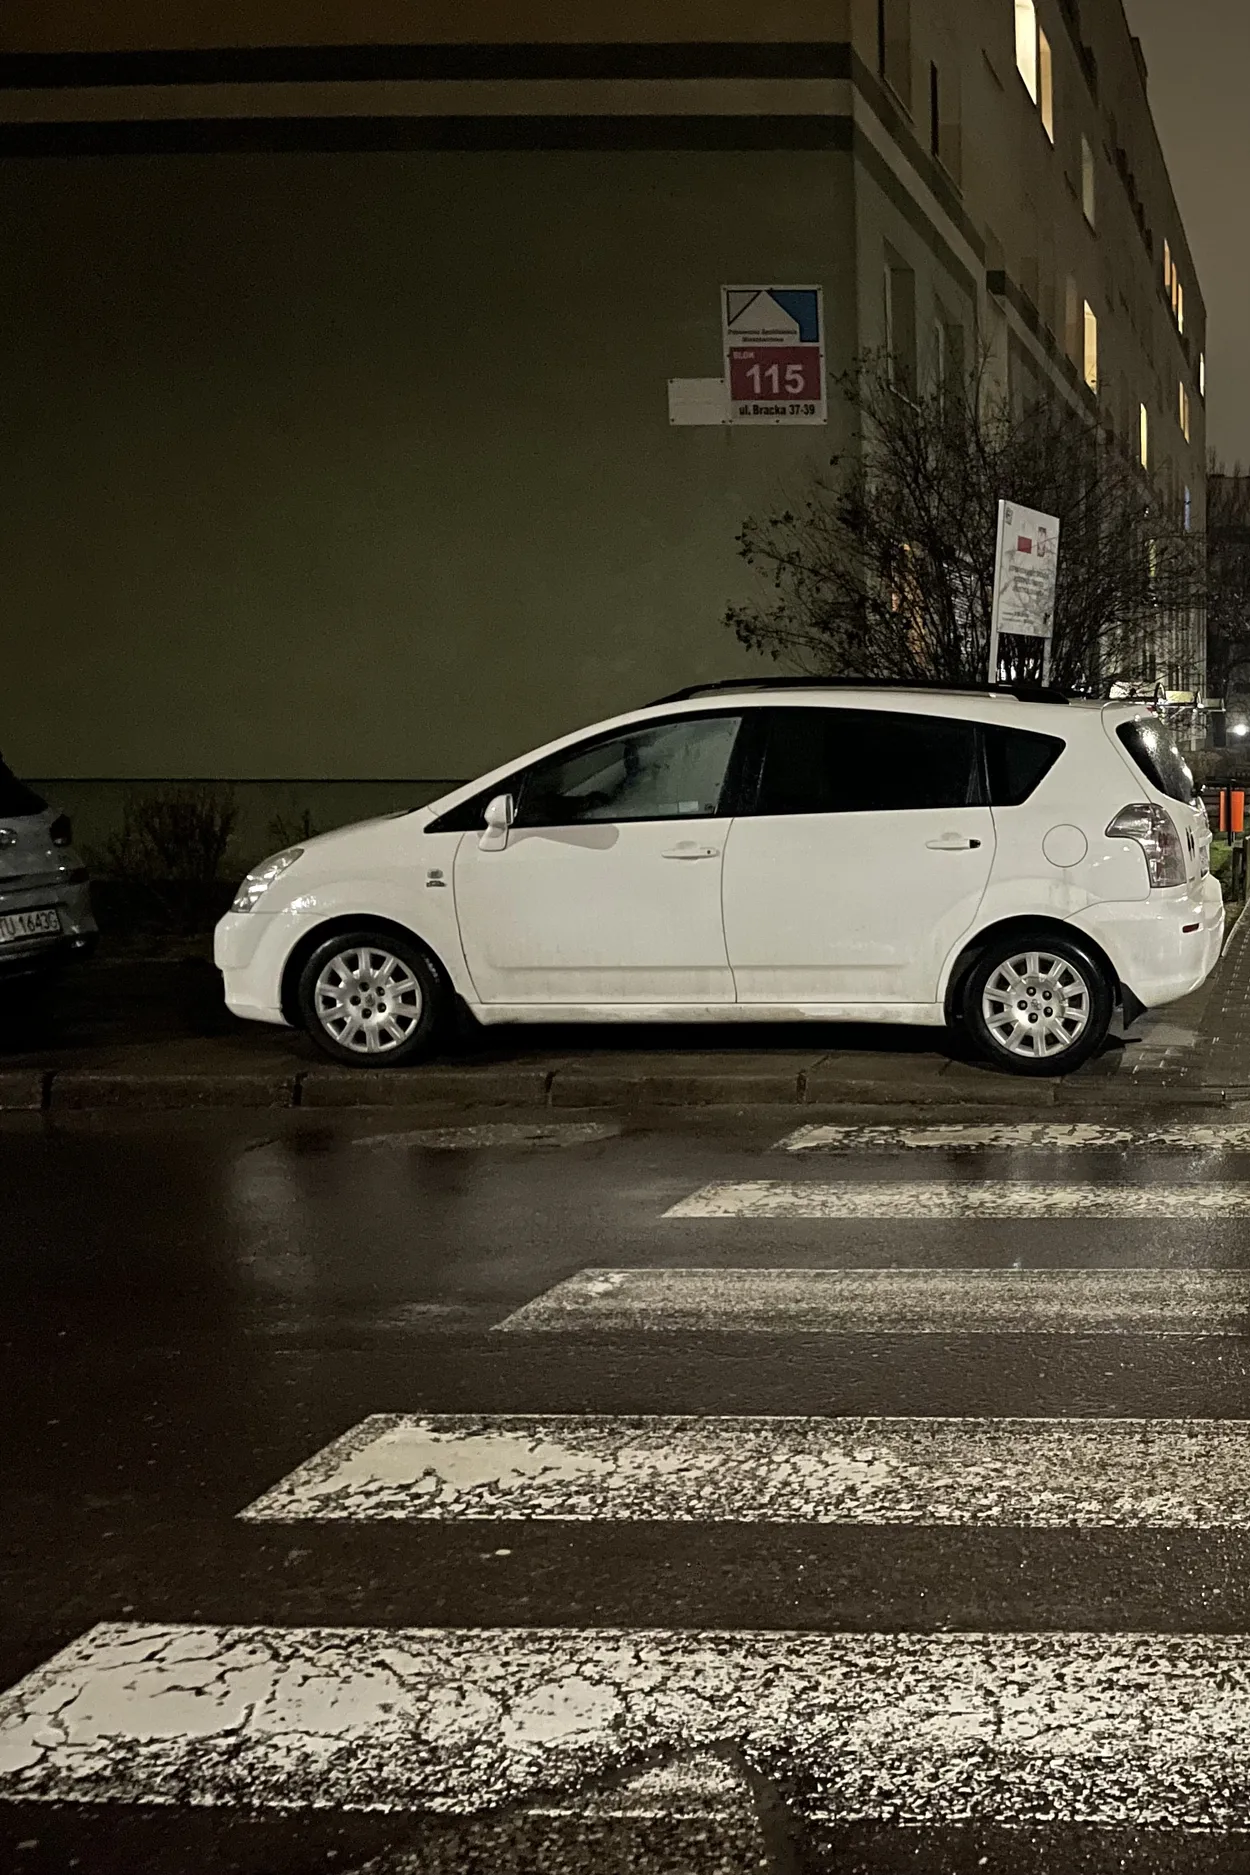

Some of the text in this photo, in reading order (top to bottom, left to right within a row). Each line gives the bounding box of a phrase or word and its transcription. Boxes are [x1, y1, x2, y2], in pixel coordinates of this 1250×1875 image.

[745, 363, 806, 395] 115
[739, 403, 816, 416] ul. Bracka 37-39
